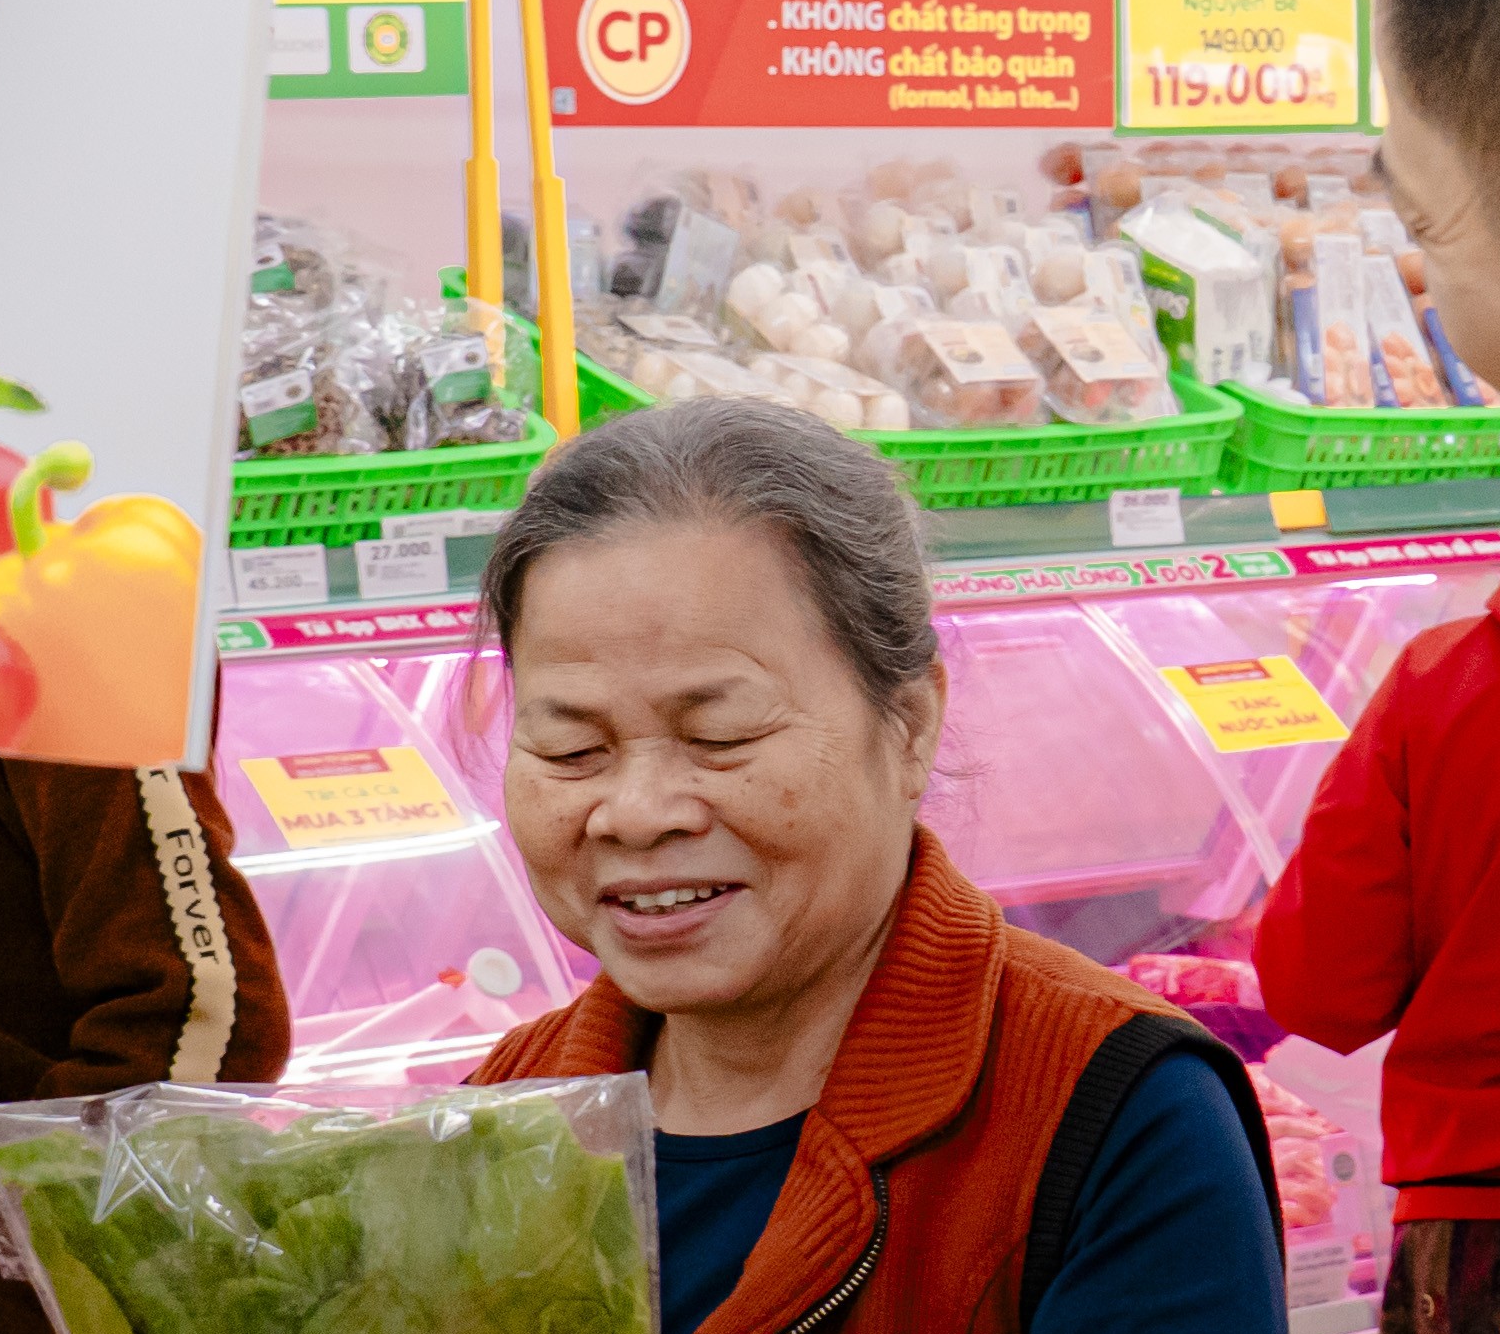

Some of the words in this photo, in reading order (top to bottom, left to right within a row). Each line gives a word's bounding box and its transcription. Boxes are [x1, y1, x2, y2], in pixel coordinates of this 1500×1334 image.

[597, 10, 671, 62] CP
[951, 3, 1014, 40] tăng
[1017, 7, 1091, 42] trọng
[887, 43, 948, 78] chất
[951, 45, 1003, 78] bảo
[1006, 46, 1075, 84] quản
[1146, 62, 1310, 107] 119.000
[280, 810, 346, 831] MUA
[347, 808, 365, 825] 3
[441, 800, 456, 816] 1
